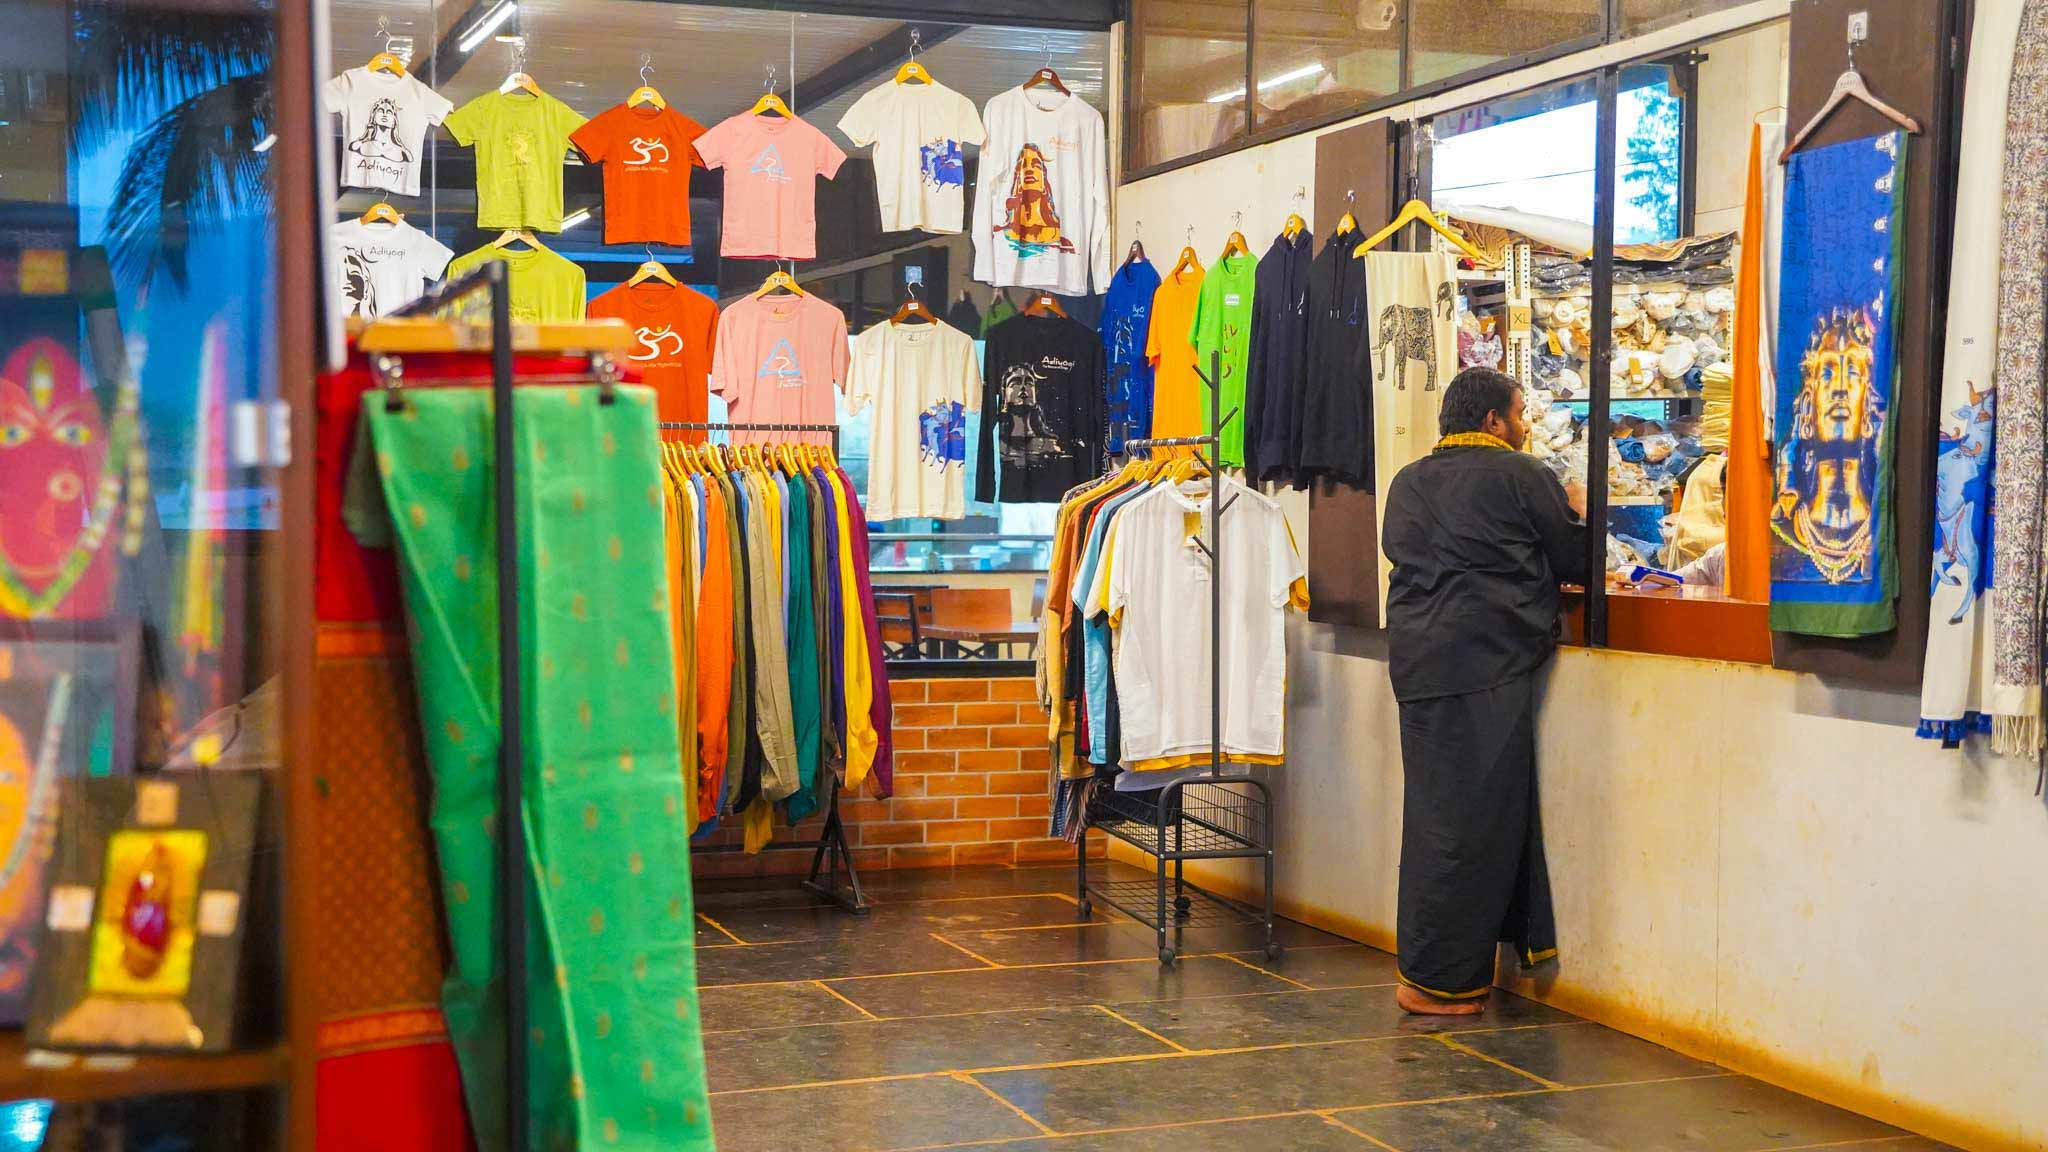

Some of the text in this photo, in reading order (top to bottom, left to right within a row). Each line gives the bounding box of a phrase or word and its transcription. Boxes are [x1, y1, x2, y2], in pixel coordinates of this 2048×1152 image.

[357, 159, 404, 184] Adiyogi
[370, 246, 406, 260] Adiyogi
[1513, 312, 1529, 324] XL
[1041, 355, 1075, 372] Adiyogi
